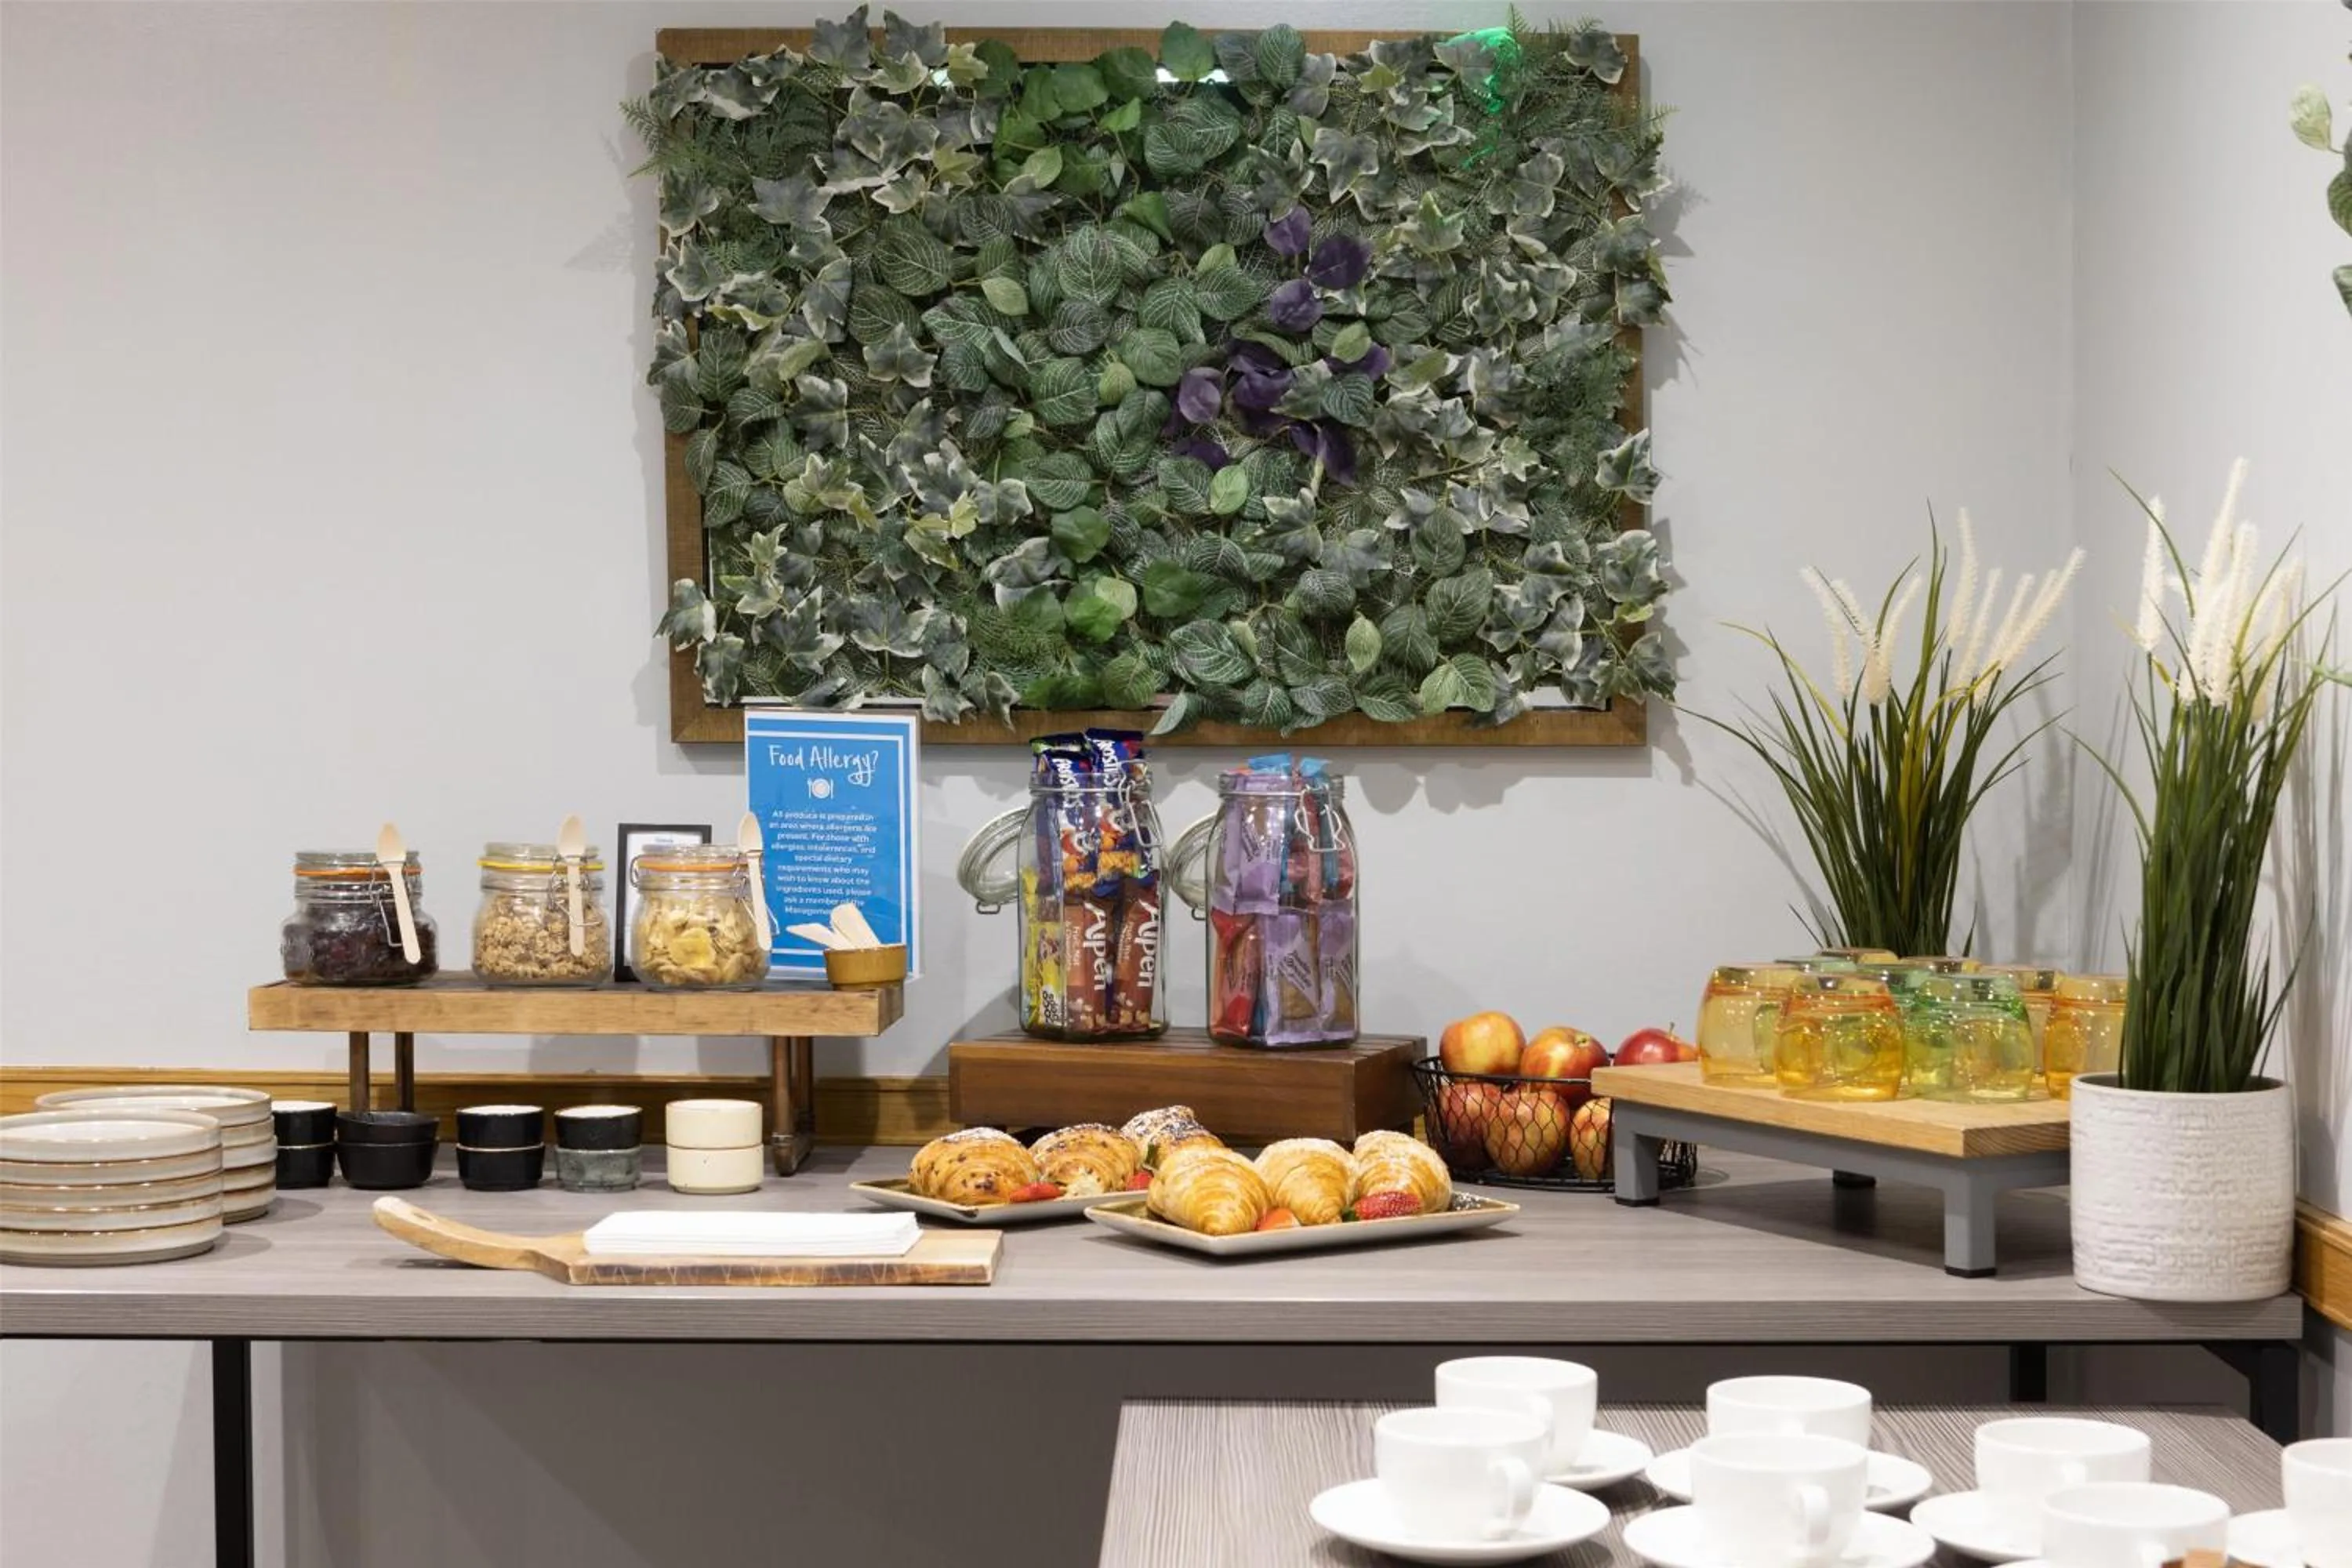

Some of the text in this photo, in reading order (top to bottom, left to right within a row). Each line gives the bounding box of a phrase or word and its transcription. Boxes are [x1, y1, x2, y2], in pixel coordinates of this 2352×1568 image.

[769, 744, 879, 787] Food Allergy?
[824, 855, 852, 865] dietary
[1083, 902, 1106, 991] Alpen
[1134, 898, 1159, 987] Alpen
